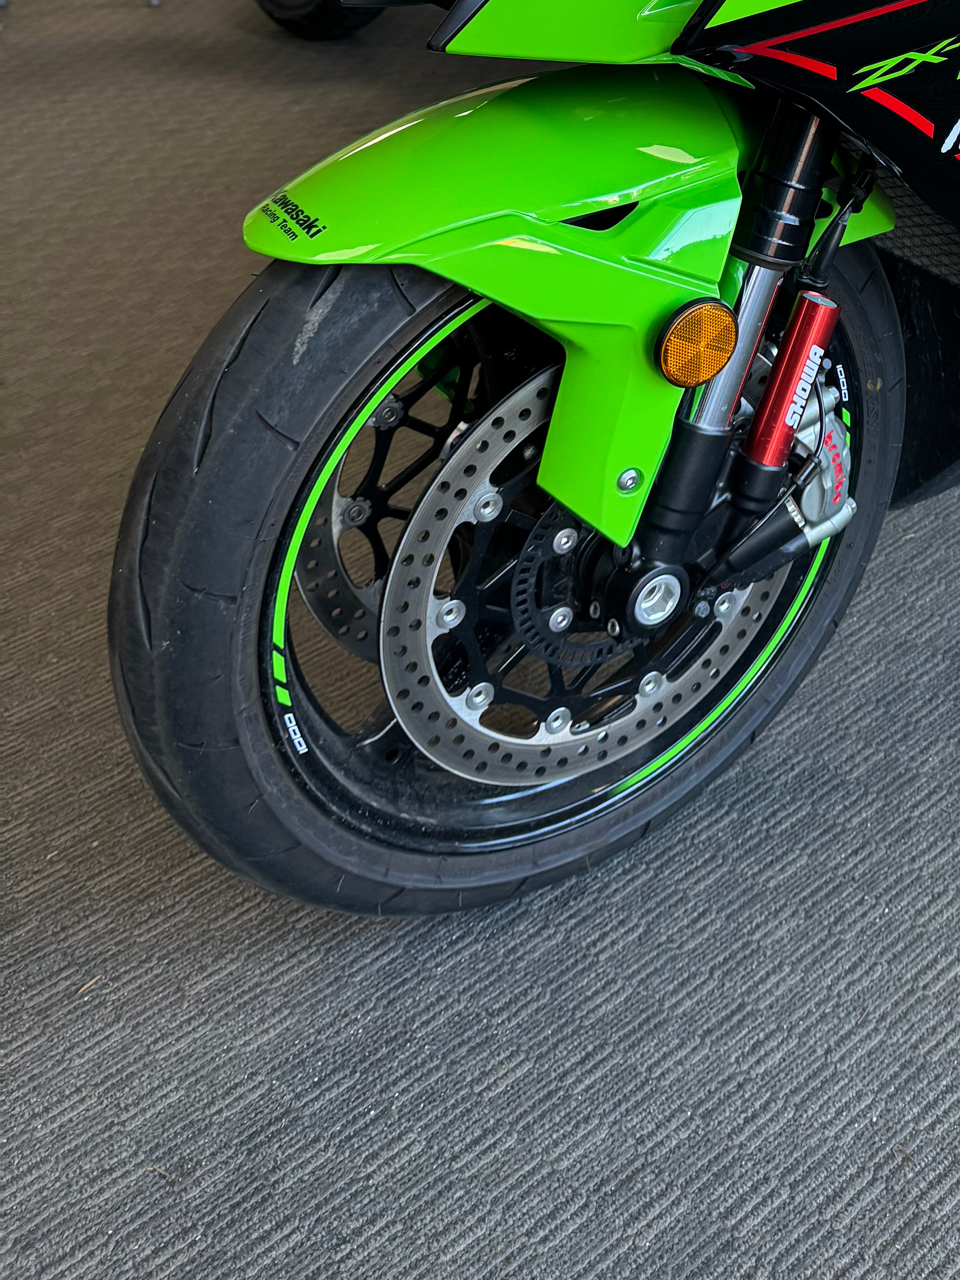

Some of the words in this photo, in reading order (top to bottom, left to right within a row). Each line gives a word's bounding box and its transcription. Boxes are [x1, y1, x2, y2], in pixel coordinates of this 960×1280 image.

[277, 219, 299, 241] Team
[785, 344, 825, 430] SHOWA
[823, 429, 848, 505] brembo
[284, 712, 309, 755] 1000
